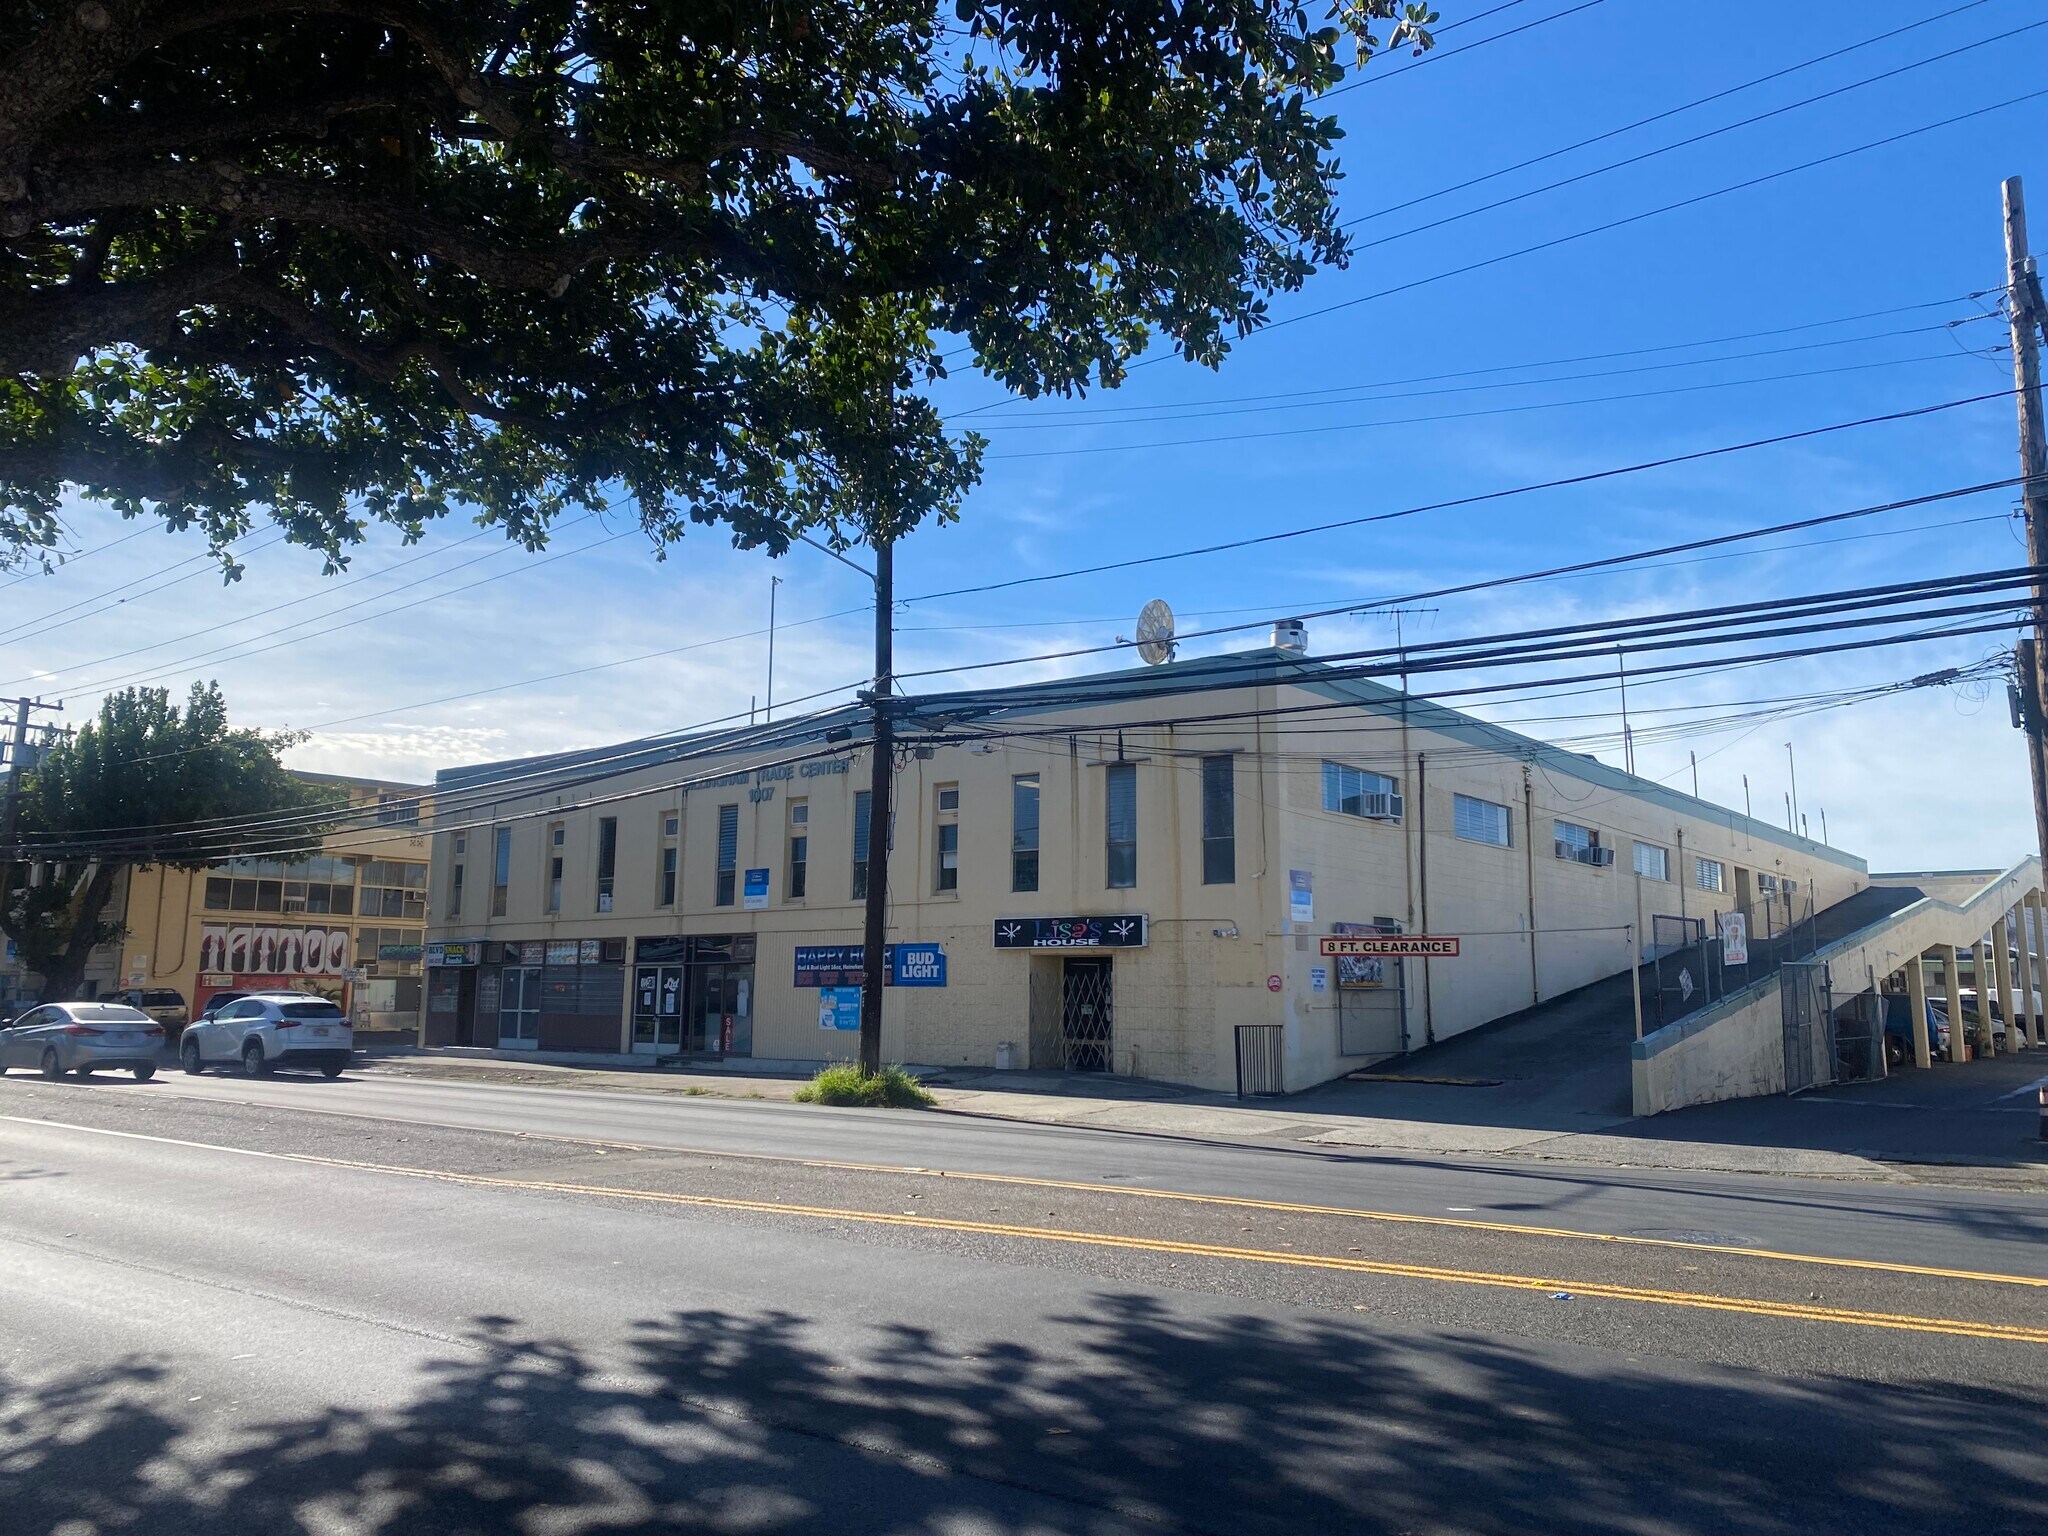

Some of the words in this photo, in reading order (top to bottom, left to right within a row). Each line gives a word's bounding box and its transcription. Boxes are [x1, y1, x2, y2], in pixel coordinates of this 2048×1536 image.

[755, 764, 794, 783] TRADE
[799, 759, 850, 778] CENTER
[748, 786, 775, 803] 1007
[1032, 918, 1102, 940] Lisa's
[1033, 938, 1100, 947] HOUSE
[1328, 942, 1336, 952] 8
[1340, 942, 1359, 952] FT.
[1362, 942, 1451, 952] CLEARANCE
[428, 946, 443, 954] BLVD
[444, 945, 465, 954] SNACK
[797, 947, 845, 963] HAPPY
[907, 952, 935, 965] BUD
[820, 964, 831, 972] Light
[902, 965, 940, 978] LIGHT
